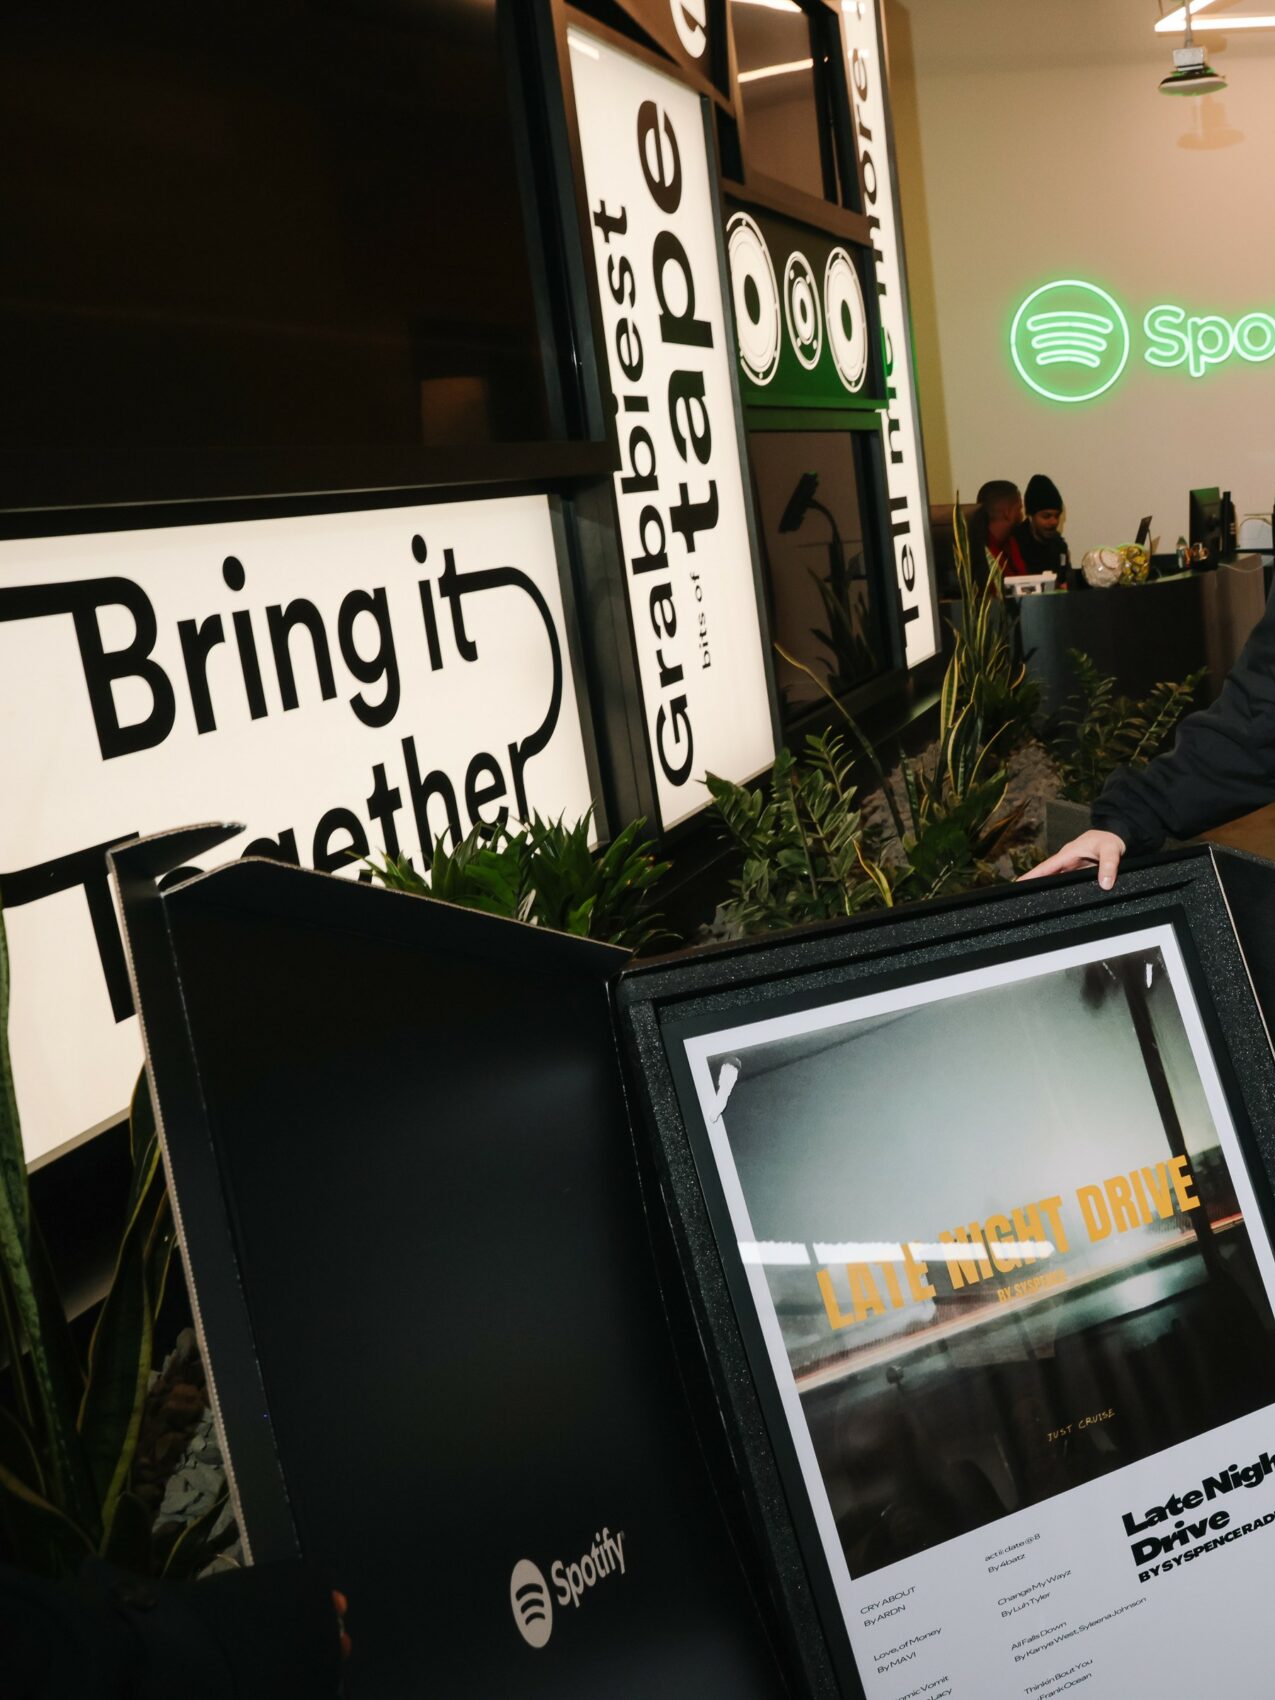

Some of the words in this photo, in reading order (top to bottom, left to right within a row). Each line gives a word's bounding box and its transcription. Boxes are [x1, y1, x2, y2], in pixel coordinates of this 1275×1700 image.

[637, 100, 719, 554] tape
[594, 200, 694, 787] Grabbiest
[688, 571, 704, 603] of
[697, 611, 712, 670] bits
[0, 555, 403, 761] Bring
[0, 735, 545, 1022] Tether
[816, 1241, 936, 1330] LATE
[938, 1196, 1069, 1290] NIGHT
[1076, 1155, 1201, 1243] DRIVE
[1047, 1424, 1073, 1442] JUST
[1078, 1408, 1116, 1429] CRUISE
[1122, 1494, 1204, 1537] Late
[984, 1552, 998, 1562] act
[1004, 1541, 1025, 1553] date
[1131, 1510, 1231, 1566] Drive
[551, 1527, 625, 1608] Spotify
[988, 1565, 1000, 1574] By
[1000, 1554, 1026, 1567] 4batz
[1138, 1565, 1160, 1583] BY
[860, 1601, 880, 1614] CRY
[881, 1586, 916, 1605] ABOUT
[998, 1587, 1032, 1606] Change
[1032, 1581, 1047, 1591] My
[1046, 1570, 1072, 1584] Wayz
[864, 1618, 876, 1627] By
[877, 1604, 906, 1622] ARDN
[1001, 1609, 1013, 1618] By
[1013, 1601, 1030, 1613] Luh
[1030, 1592, 1051, 1605] Tyler
[899, 1640, 909, 1650] of
[909, 1628, 942, 1646] Money
[1011, 1641, 1022, 1651] All
[1022, 1633, 1040, 1646] Falls
[1040, 1621, 1067, 1637] Down
[1015, 1654, 1027, 1663] By
[1026, 1641, 1054, 1658] Kanye
[1111, 1597, 1147, 1617] Johnson
[877, 1665, 889, 1674] By
[890, 1651, 917, 1668] MAVI
[1055, 1667, 1075, 1681] Bout
[1075, 1659, 1094, 1671] You
[920, 1675, 949, 1691] Vomit
[1064, 1673, 1092, 1689] Ocean
